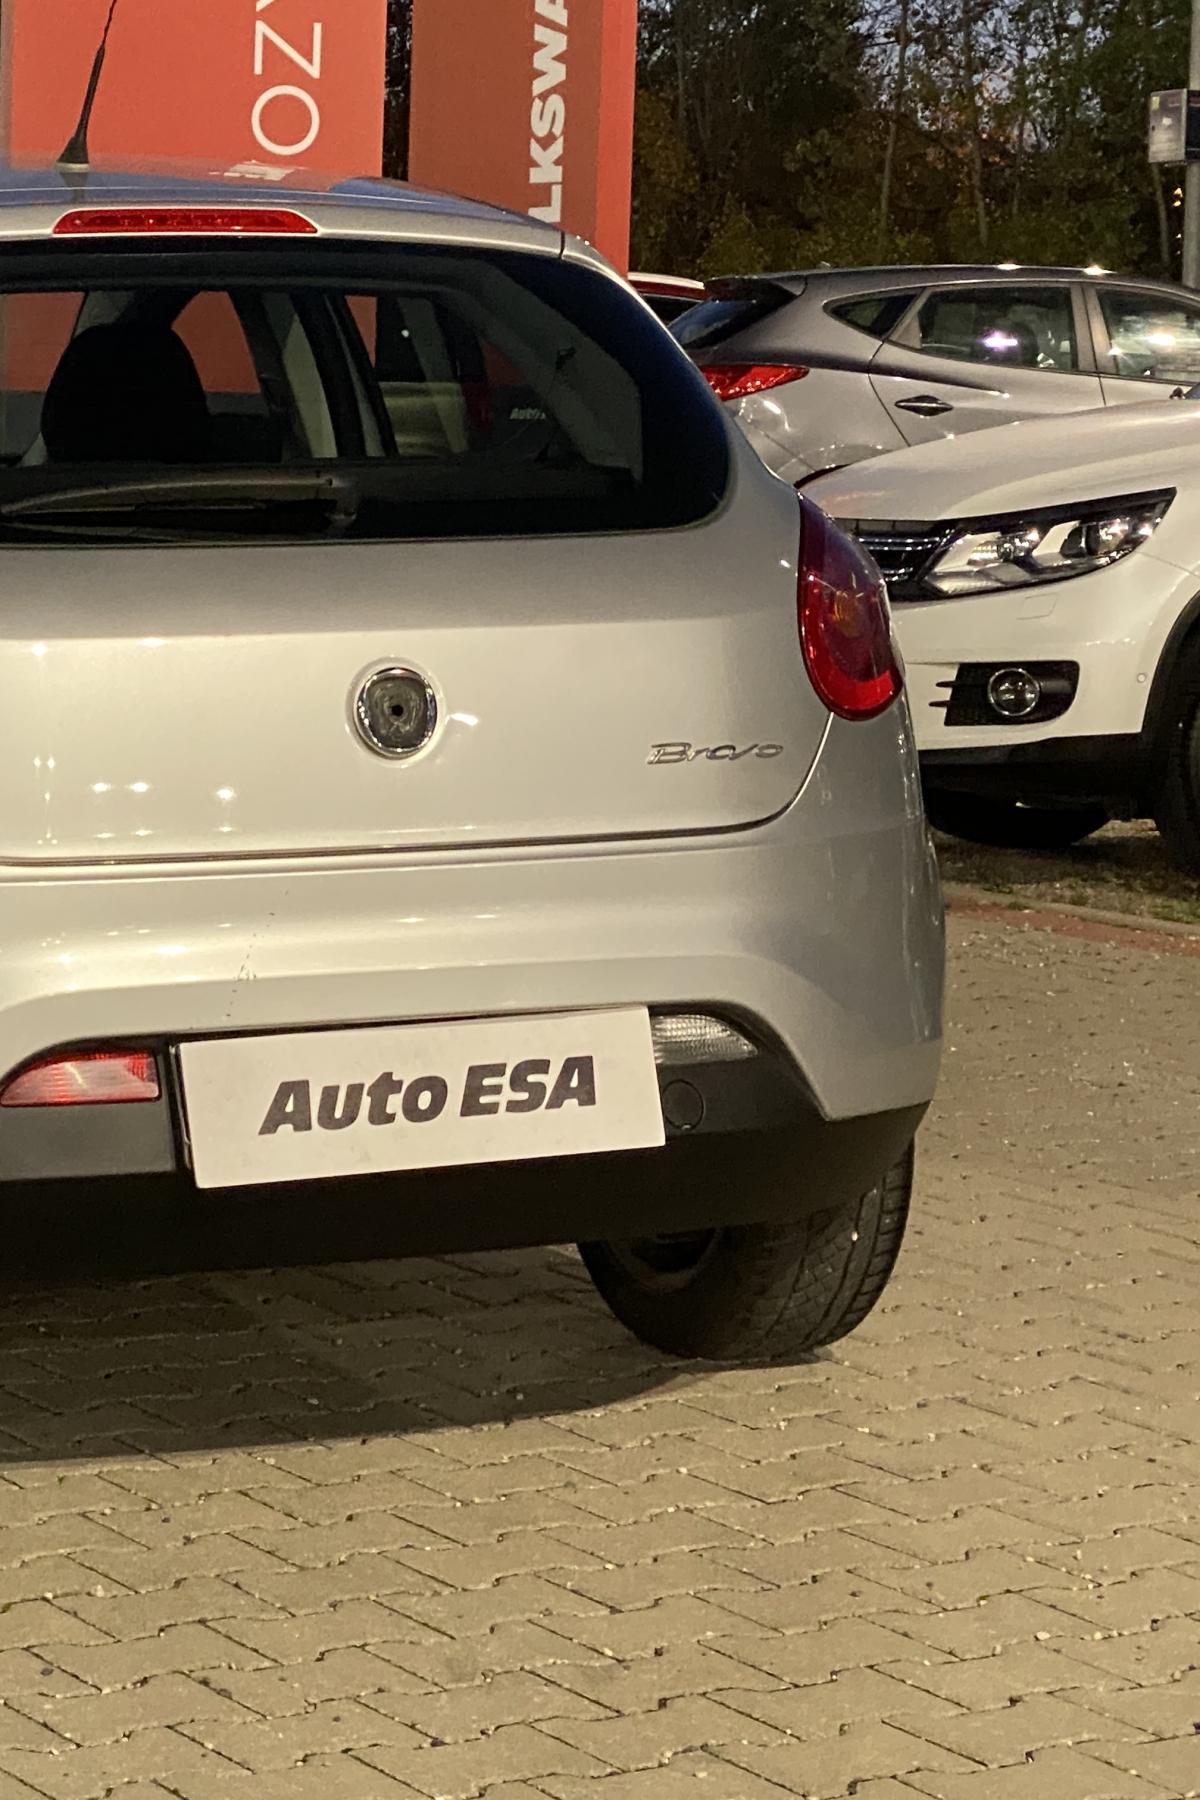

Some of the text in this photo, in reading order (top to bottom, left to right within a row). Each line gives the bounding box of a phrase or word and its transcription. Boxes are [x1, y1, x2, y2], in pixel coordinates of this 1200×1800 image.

[251, 0, 322, 156] OZ
[647, 742, 784, 765] Bravo
[257, 1055, 597, 1136] Auto ESA
